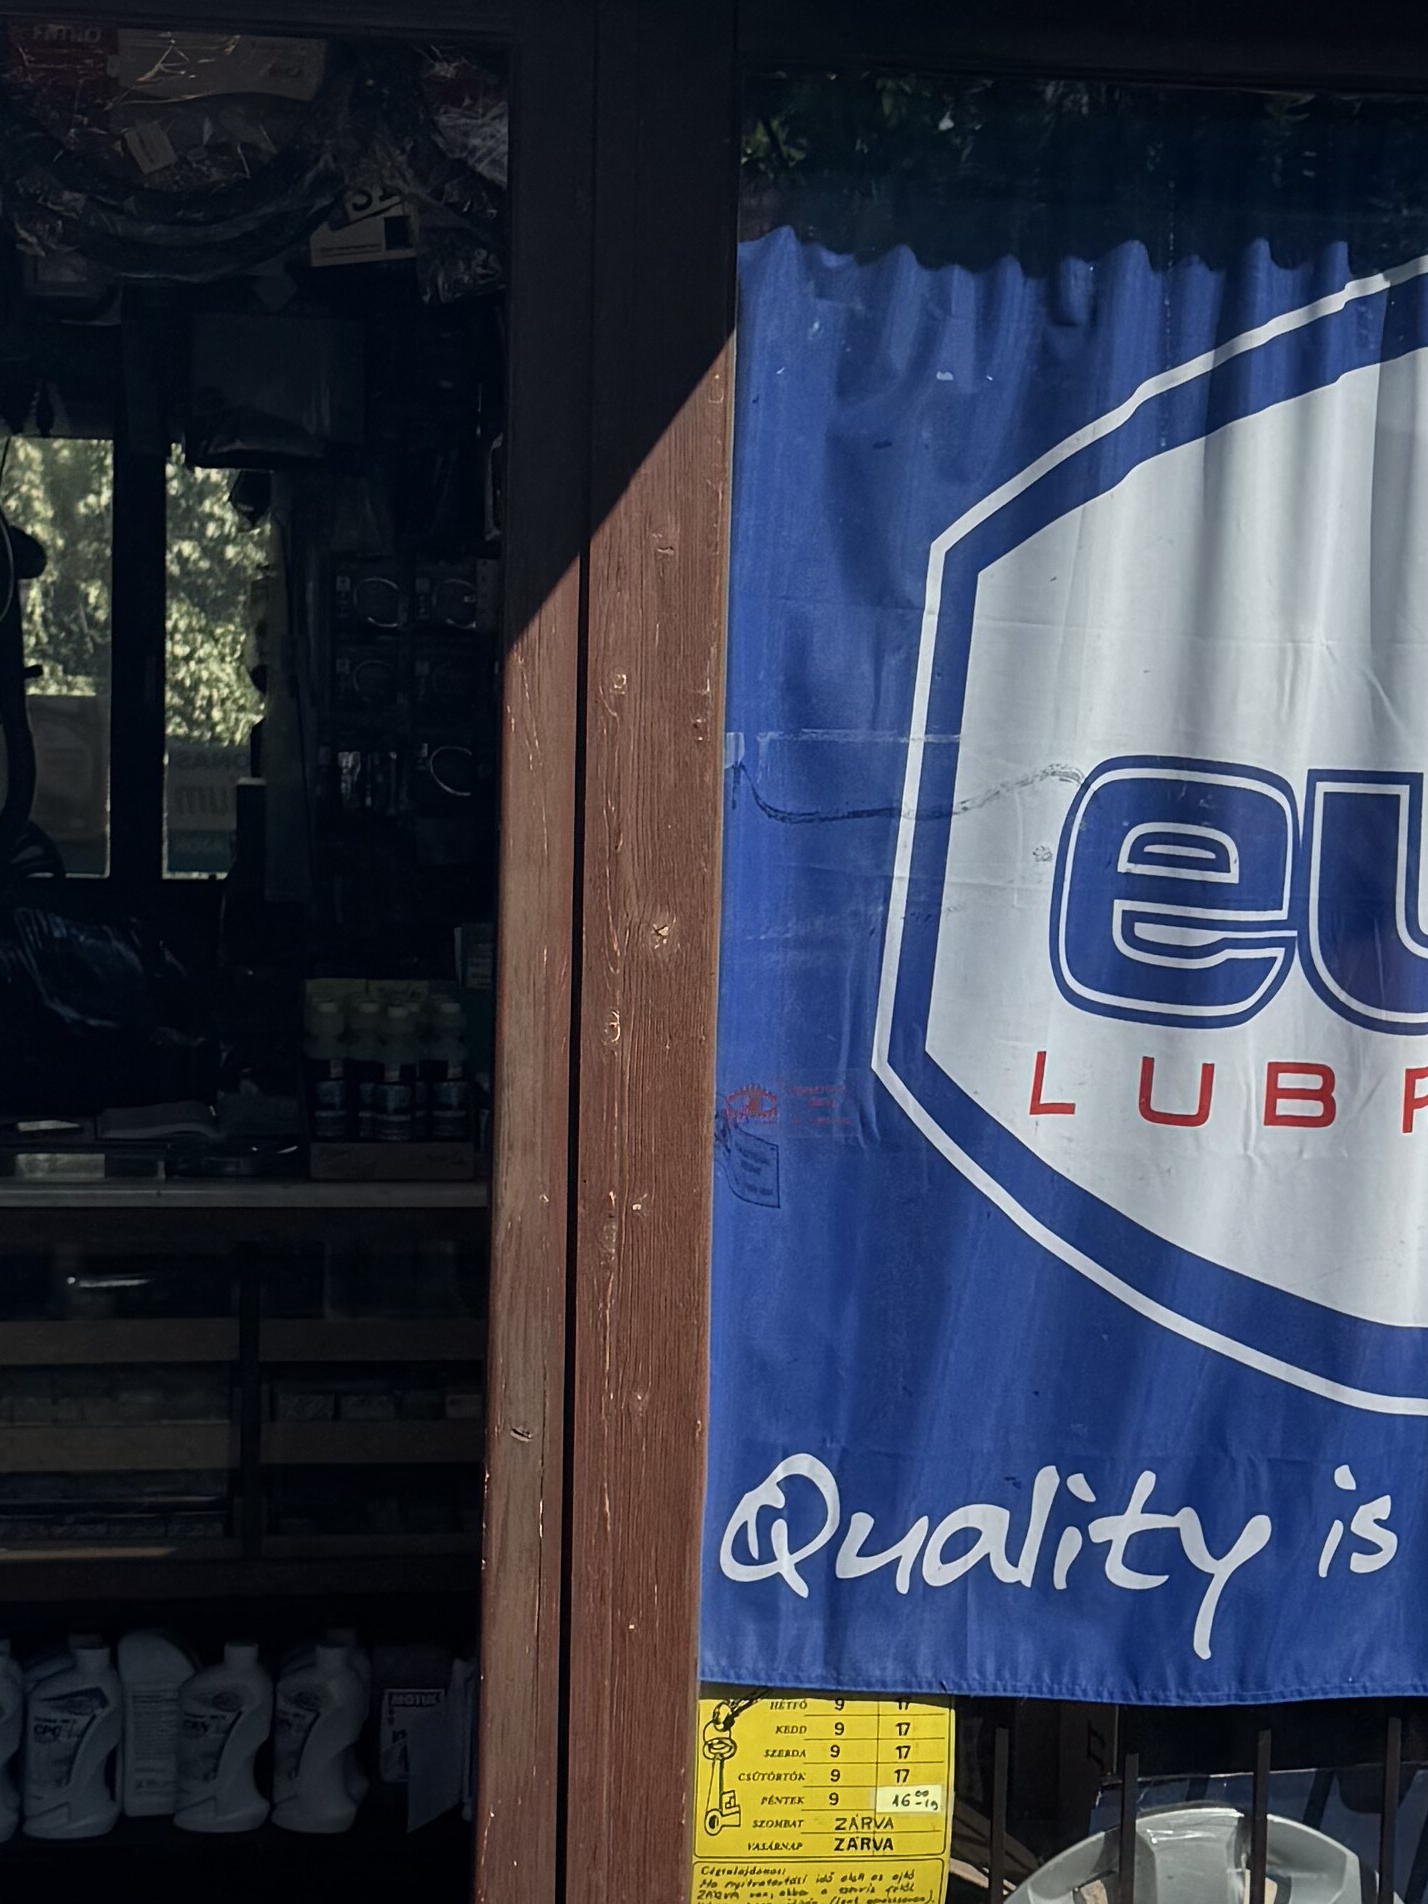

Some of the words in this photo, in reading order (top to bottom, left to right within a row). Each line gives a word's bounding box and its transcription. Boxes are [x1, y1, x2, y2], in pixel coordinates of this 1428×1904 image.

[719, 1452, 1272, 1660] Quality
[1317, 1463, 1399, 1578] is
[834, 1697, 845, 1711] 9
[775, 1725, 808, 1735] KEDD
[834, 1722, 845, 1735] 9
[895, 1722, 911, 1736] 17
[763, 1748, 806, 1758] SZERDA
[830, 1745, 841, 1758] 9
[895, 1745, 911, 1759] 17
[830, 1769, 841, 1782] 9
[894, 1769, 910, 1783] 17
[761, 1794, 805, 1806] PÉNTEK
[829, 1792, 840, 1806] 9
[752, 1819, 805, 1829] SZOMBAT
[834, 1814, 894, 1831] ZÁRVA
[747, 1840, 803, 1851] VASÁRNAP
[834, 1836, 894, 1852] ZÁRVA
